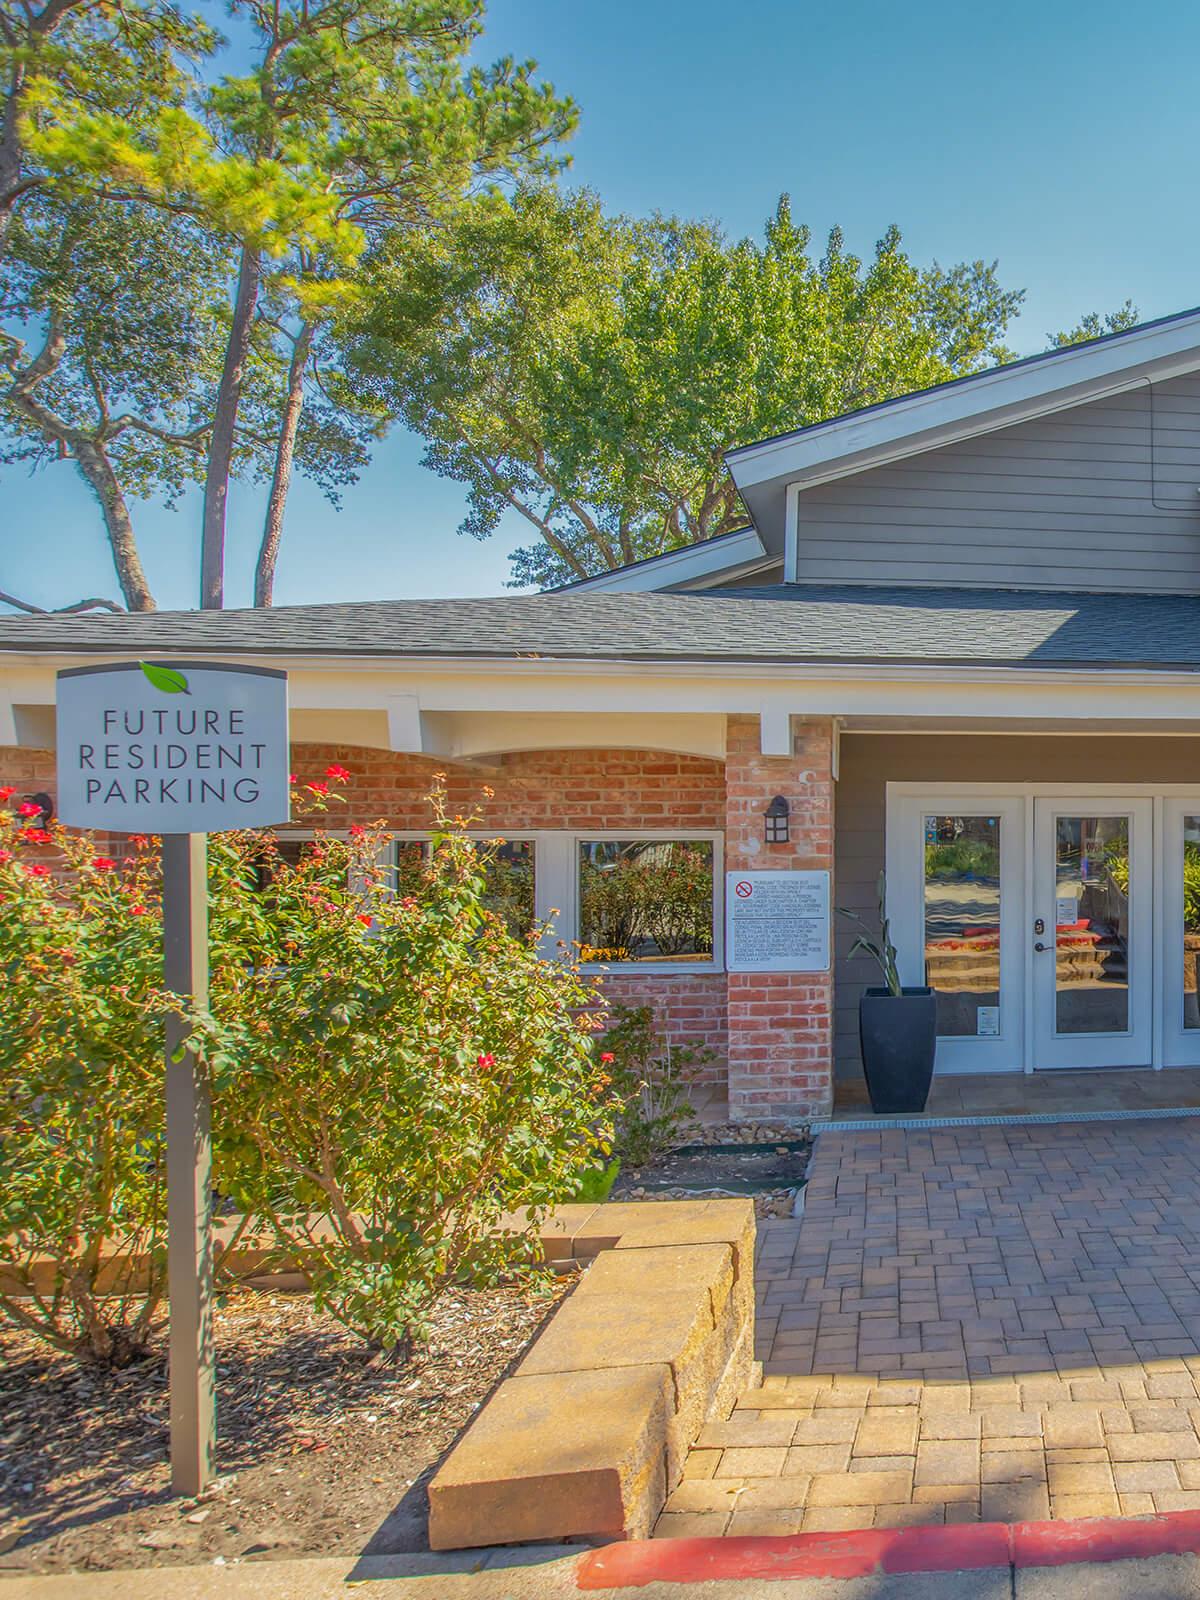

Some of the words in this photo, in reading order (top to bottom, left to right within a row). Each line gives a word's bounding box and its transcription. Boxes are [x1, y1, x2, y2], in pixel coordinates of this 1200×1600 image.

[103, 710, 244, 735] FUTURE
[79, 744, 267, 769] RESIDENT
[86, 778, 260, 804] PARKING
